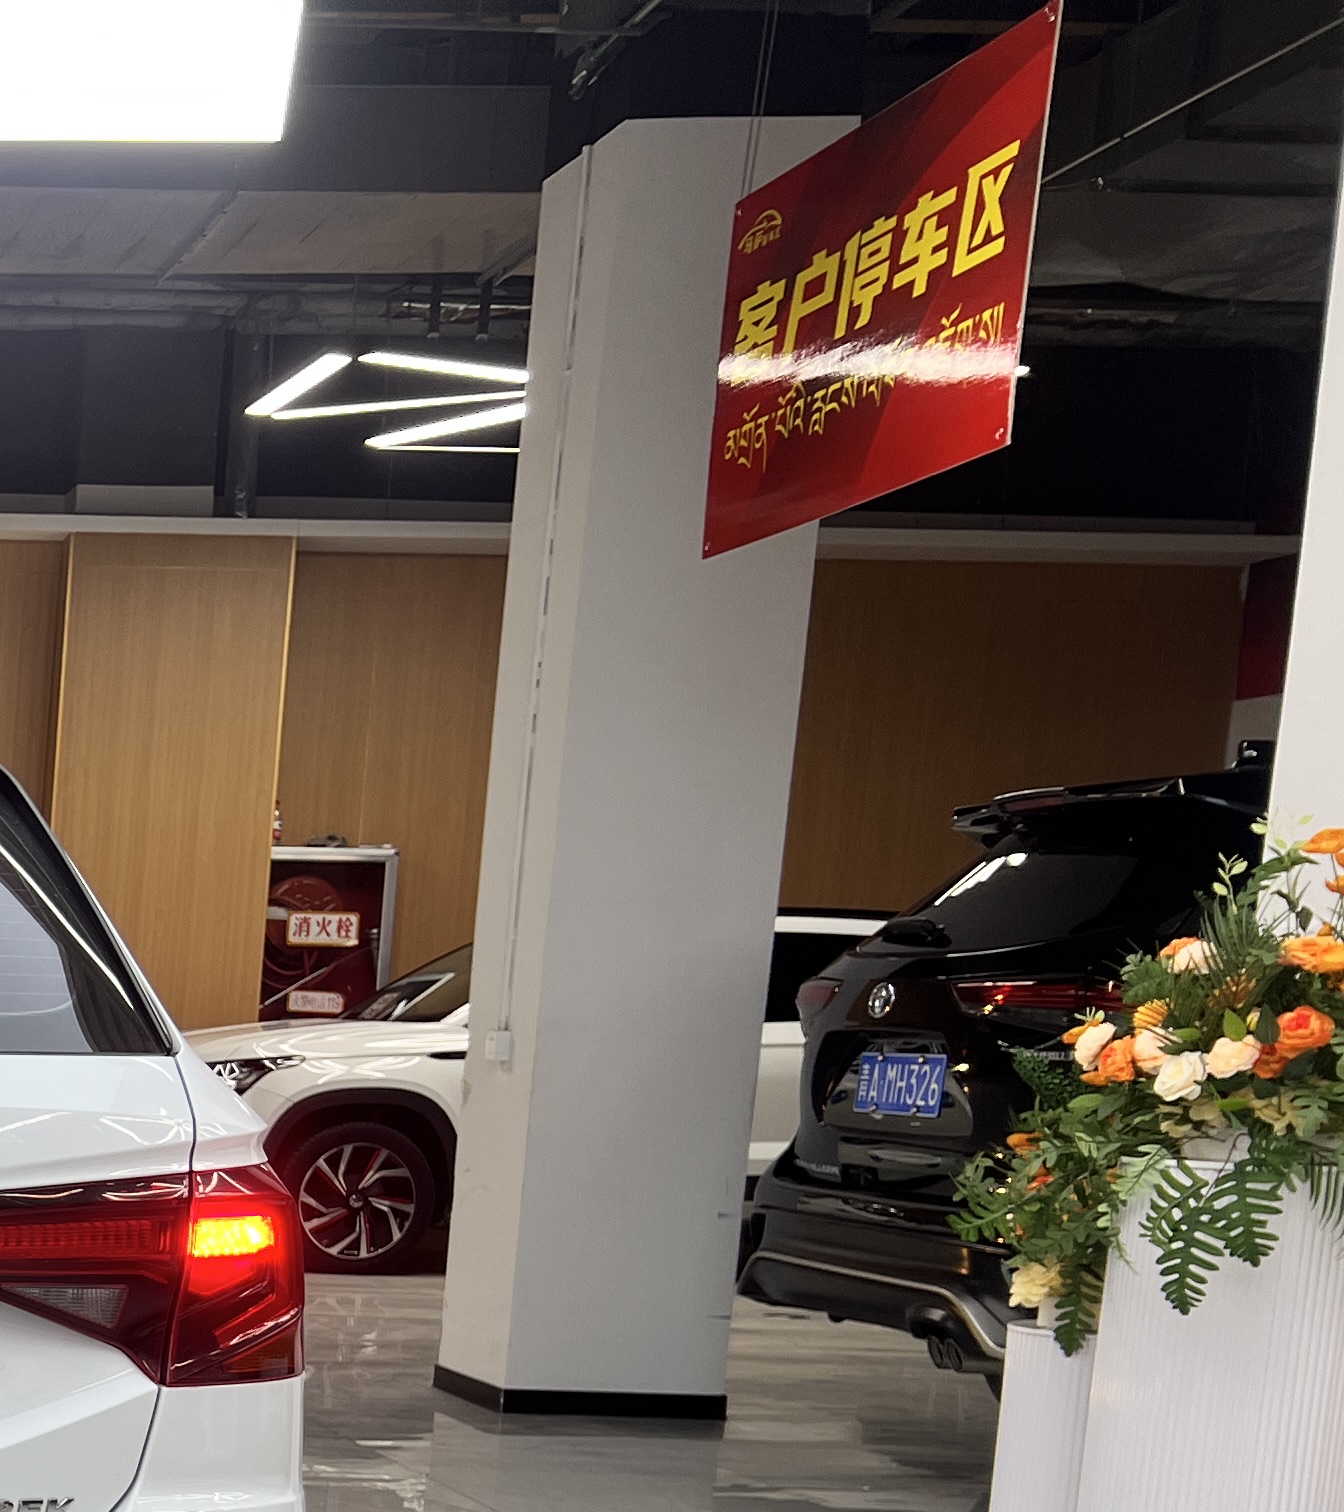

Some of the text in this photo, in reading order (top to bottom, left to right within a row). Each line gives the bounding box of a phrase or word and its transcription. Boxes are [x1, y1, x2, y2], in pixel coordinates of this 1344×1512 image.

[731, 139, 1021, 386] 客户停车区
[293, 916, 354, 939] 消火栓
